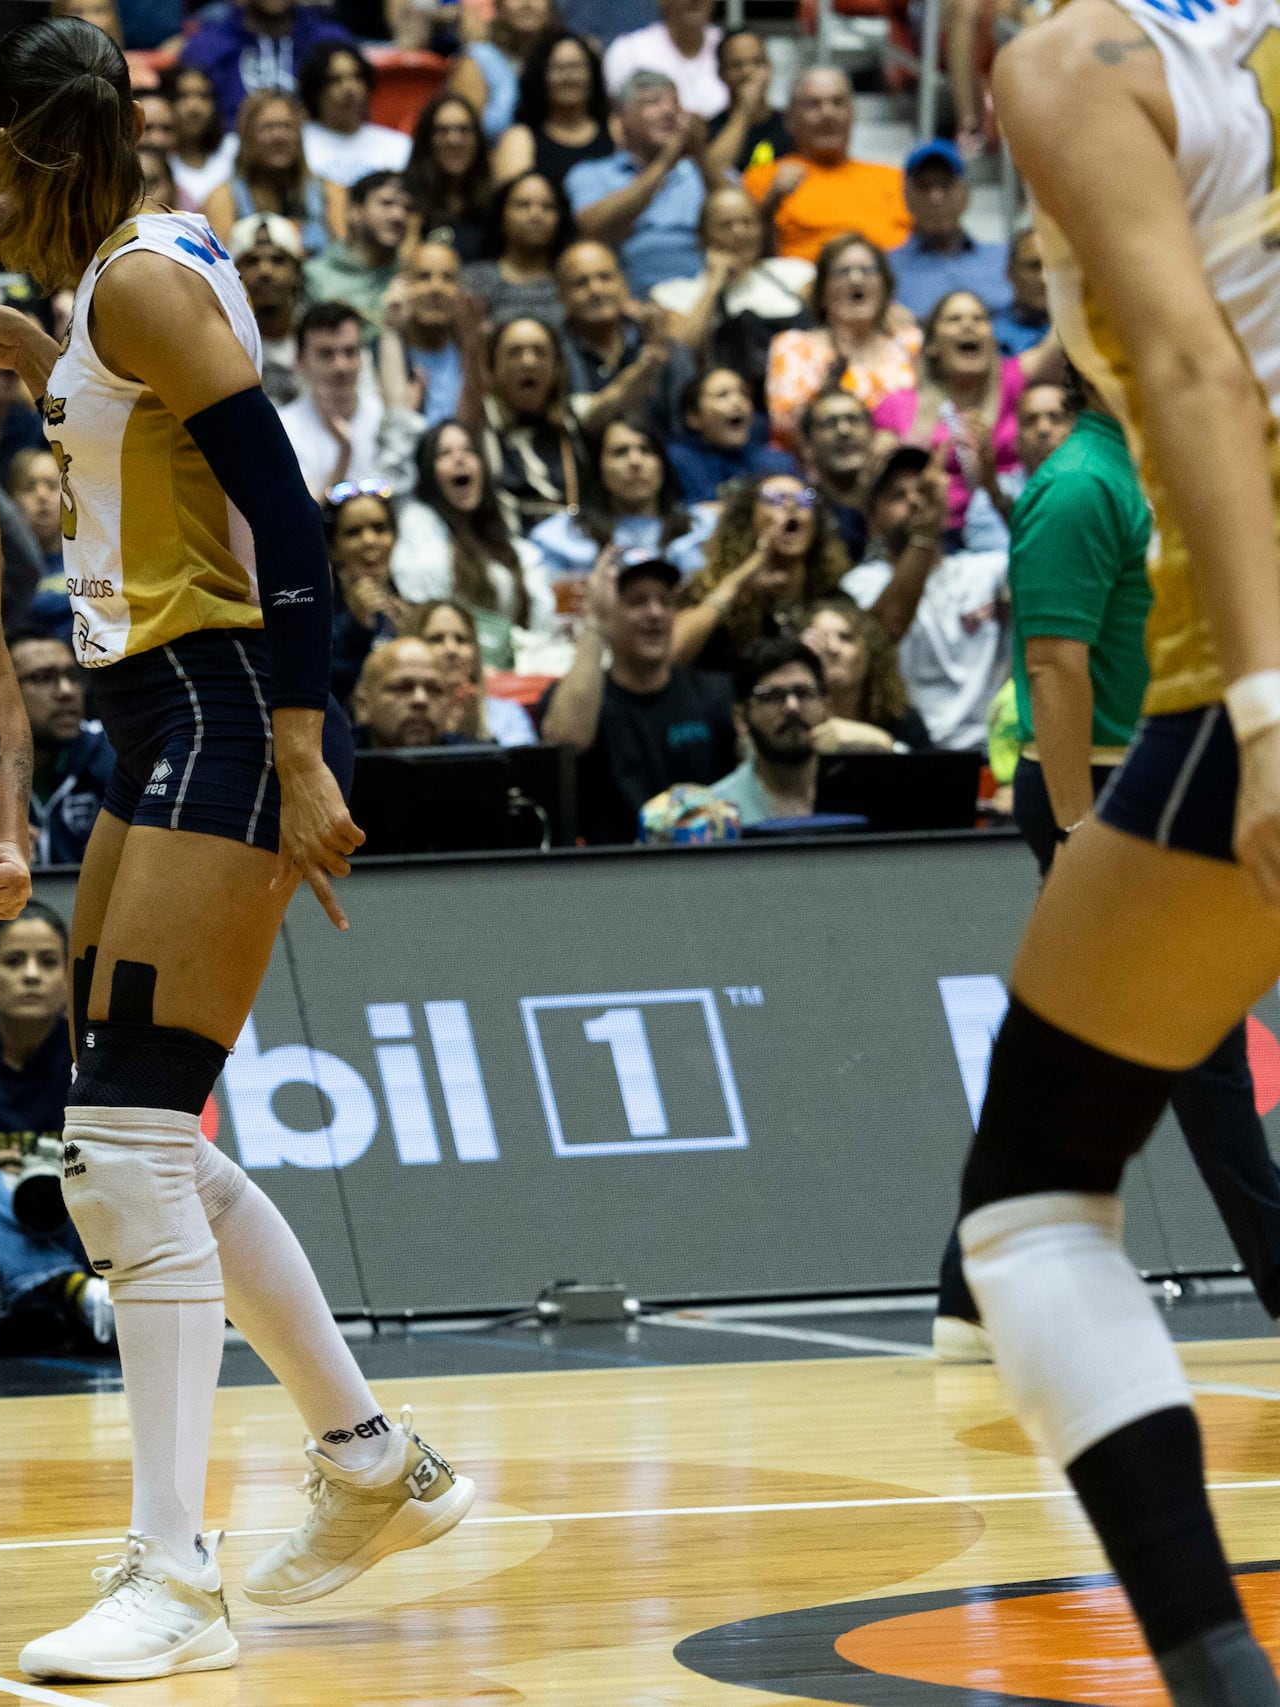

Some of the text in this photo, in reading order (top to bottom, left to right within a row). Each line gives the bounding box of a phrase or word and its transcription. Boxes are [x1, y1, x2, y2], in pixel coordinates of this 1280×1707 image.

[584, 1007, 670, 1139] 1
[354, 1413, 391, 1439] err
[405, 1458, 439, 1499] 13
